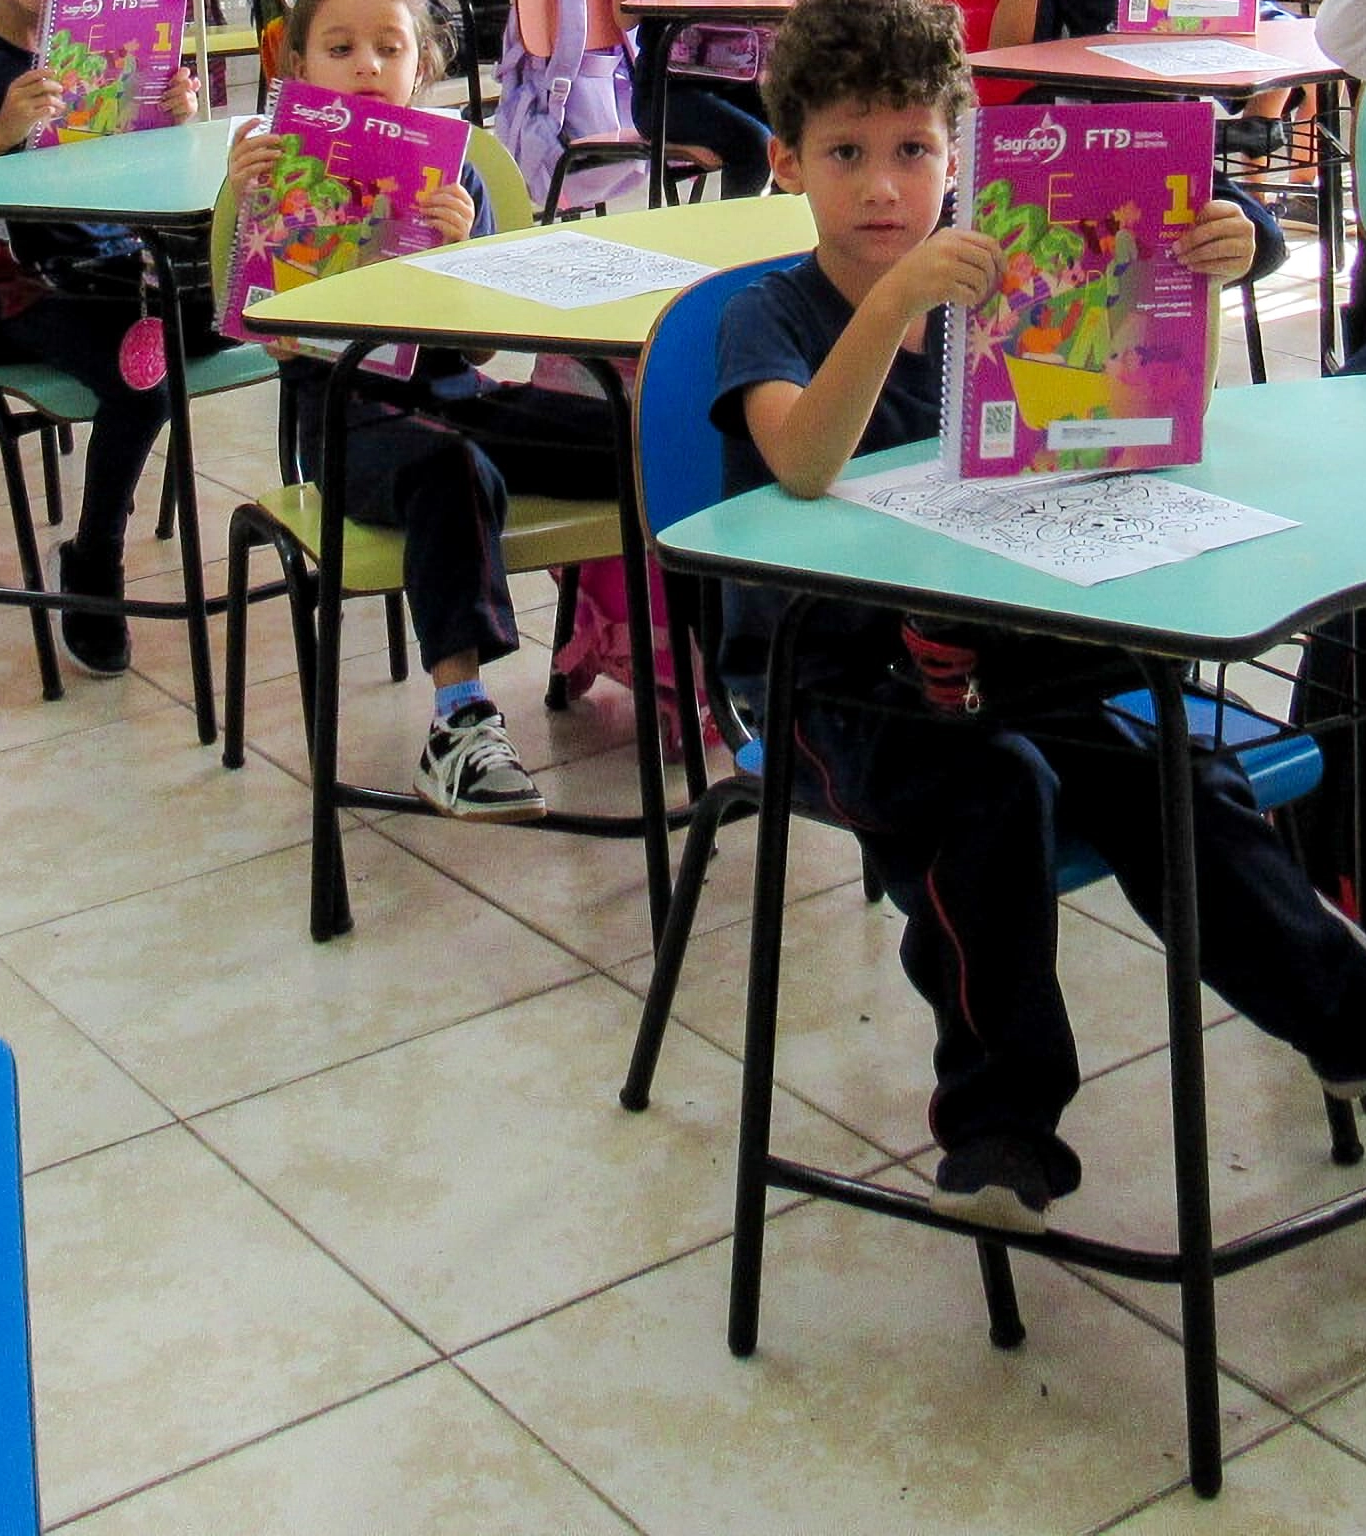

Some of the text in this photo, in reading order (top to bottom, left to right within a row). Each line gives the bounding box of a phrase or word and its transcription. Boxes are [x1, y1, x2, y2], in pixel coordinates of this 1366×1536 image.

[152, 23, 172, 51] 1
[365, 117, 403, 138] FTD
[1086, 128, 1132, 151] FTD
[1163, 175, 1196, 225] 1
